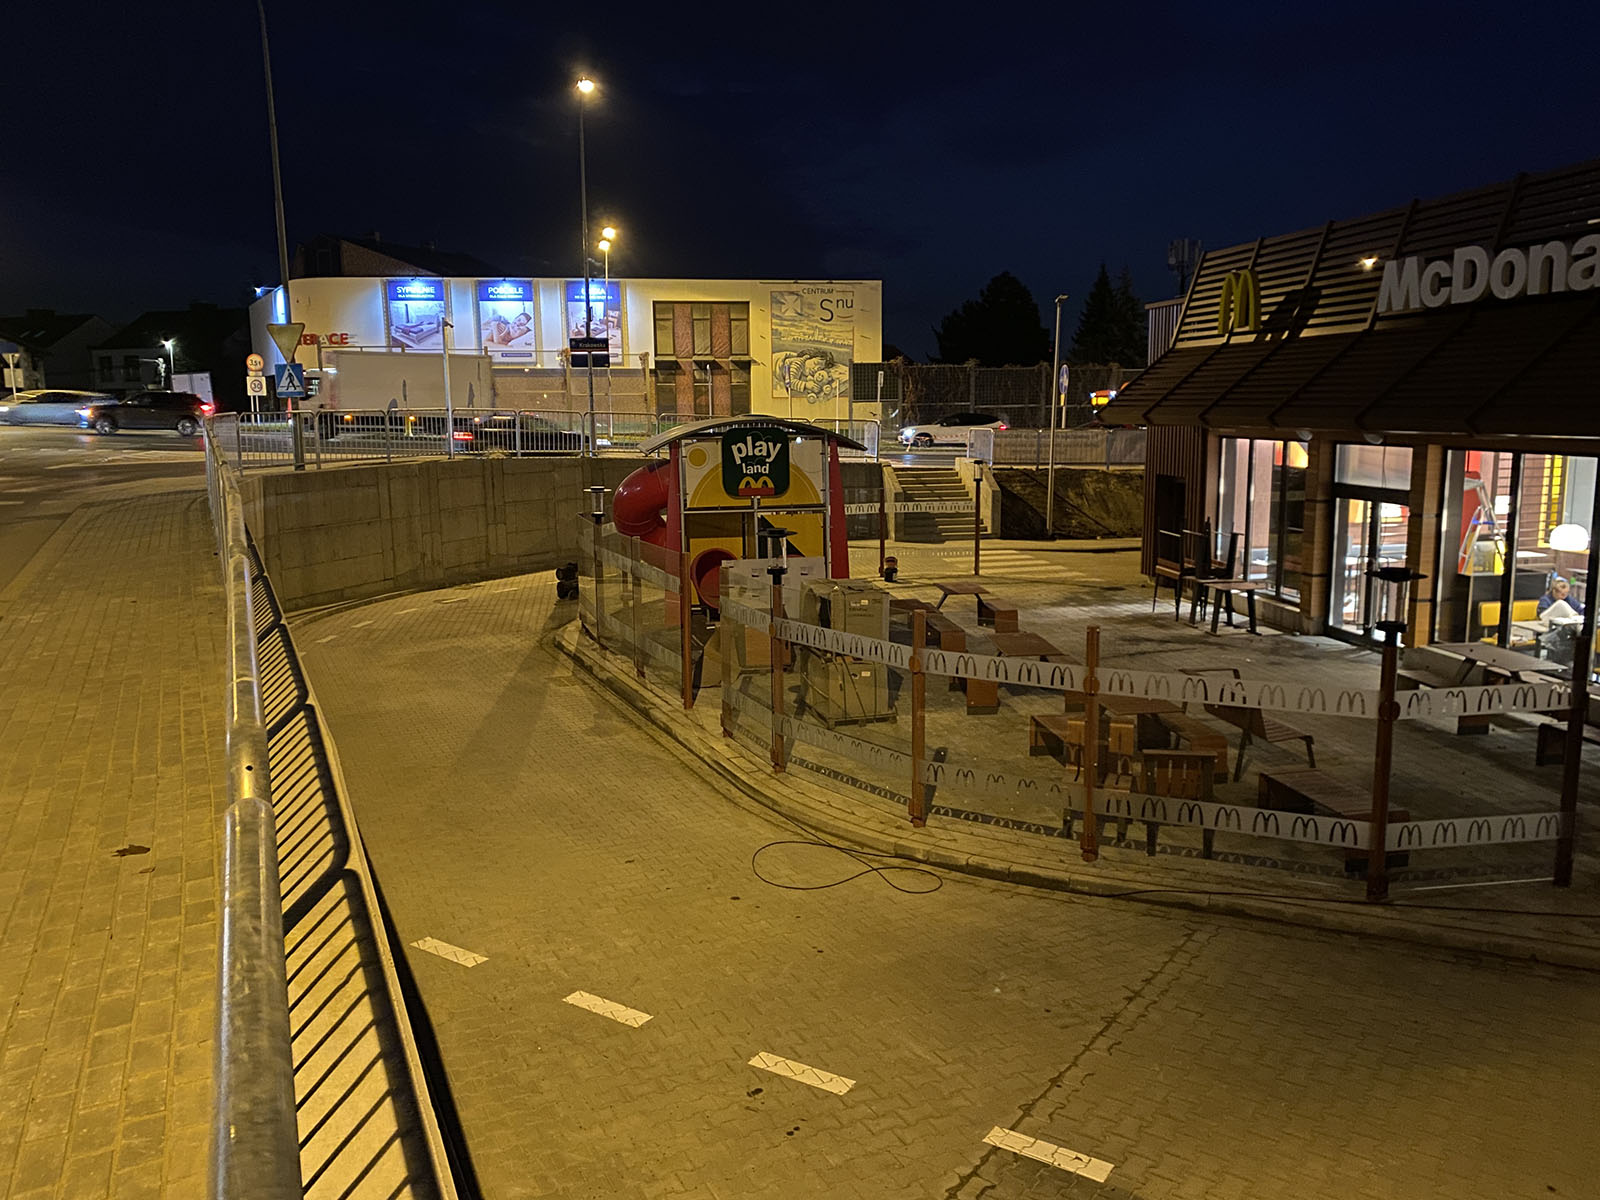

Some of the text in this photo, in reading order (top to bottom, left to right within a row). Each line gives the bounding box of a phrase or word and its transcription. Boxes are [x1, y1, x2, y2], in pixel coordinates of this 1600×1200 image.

[801, 287, 835, 295] CENTRUM
[731, 436, 782, 465] play
[742, 463, 769, 475] land
